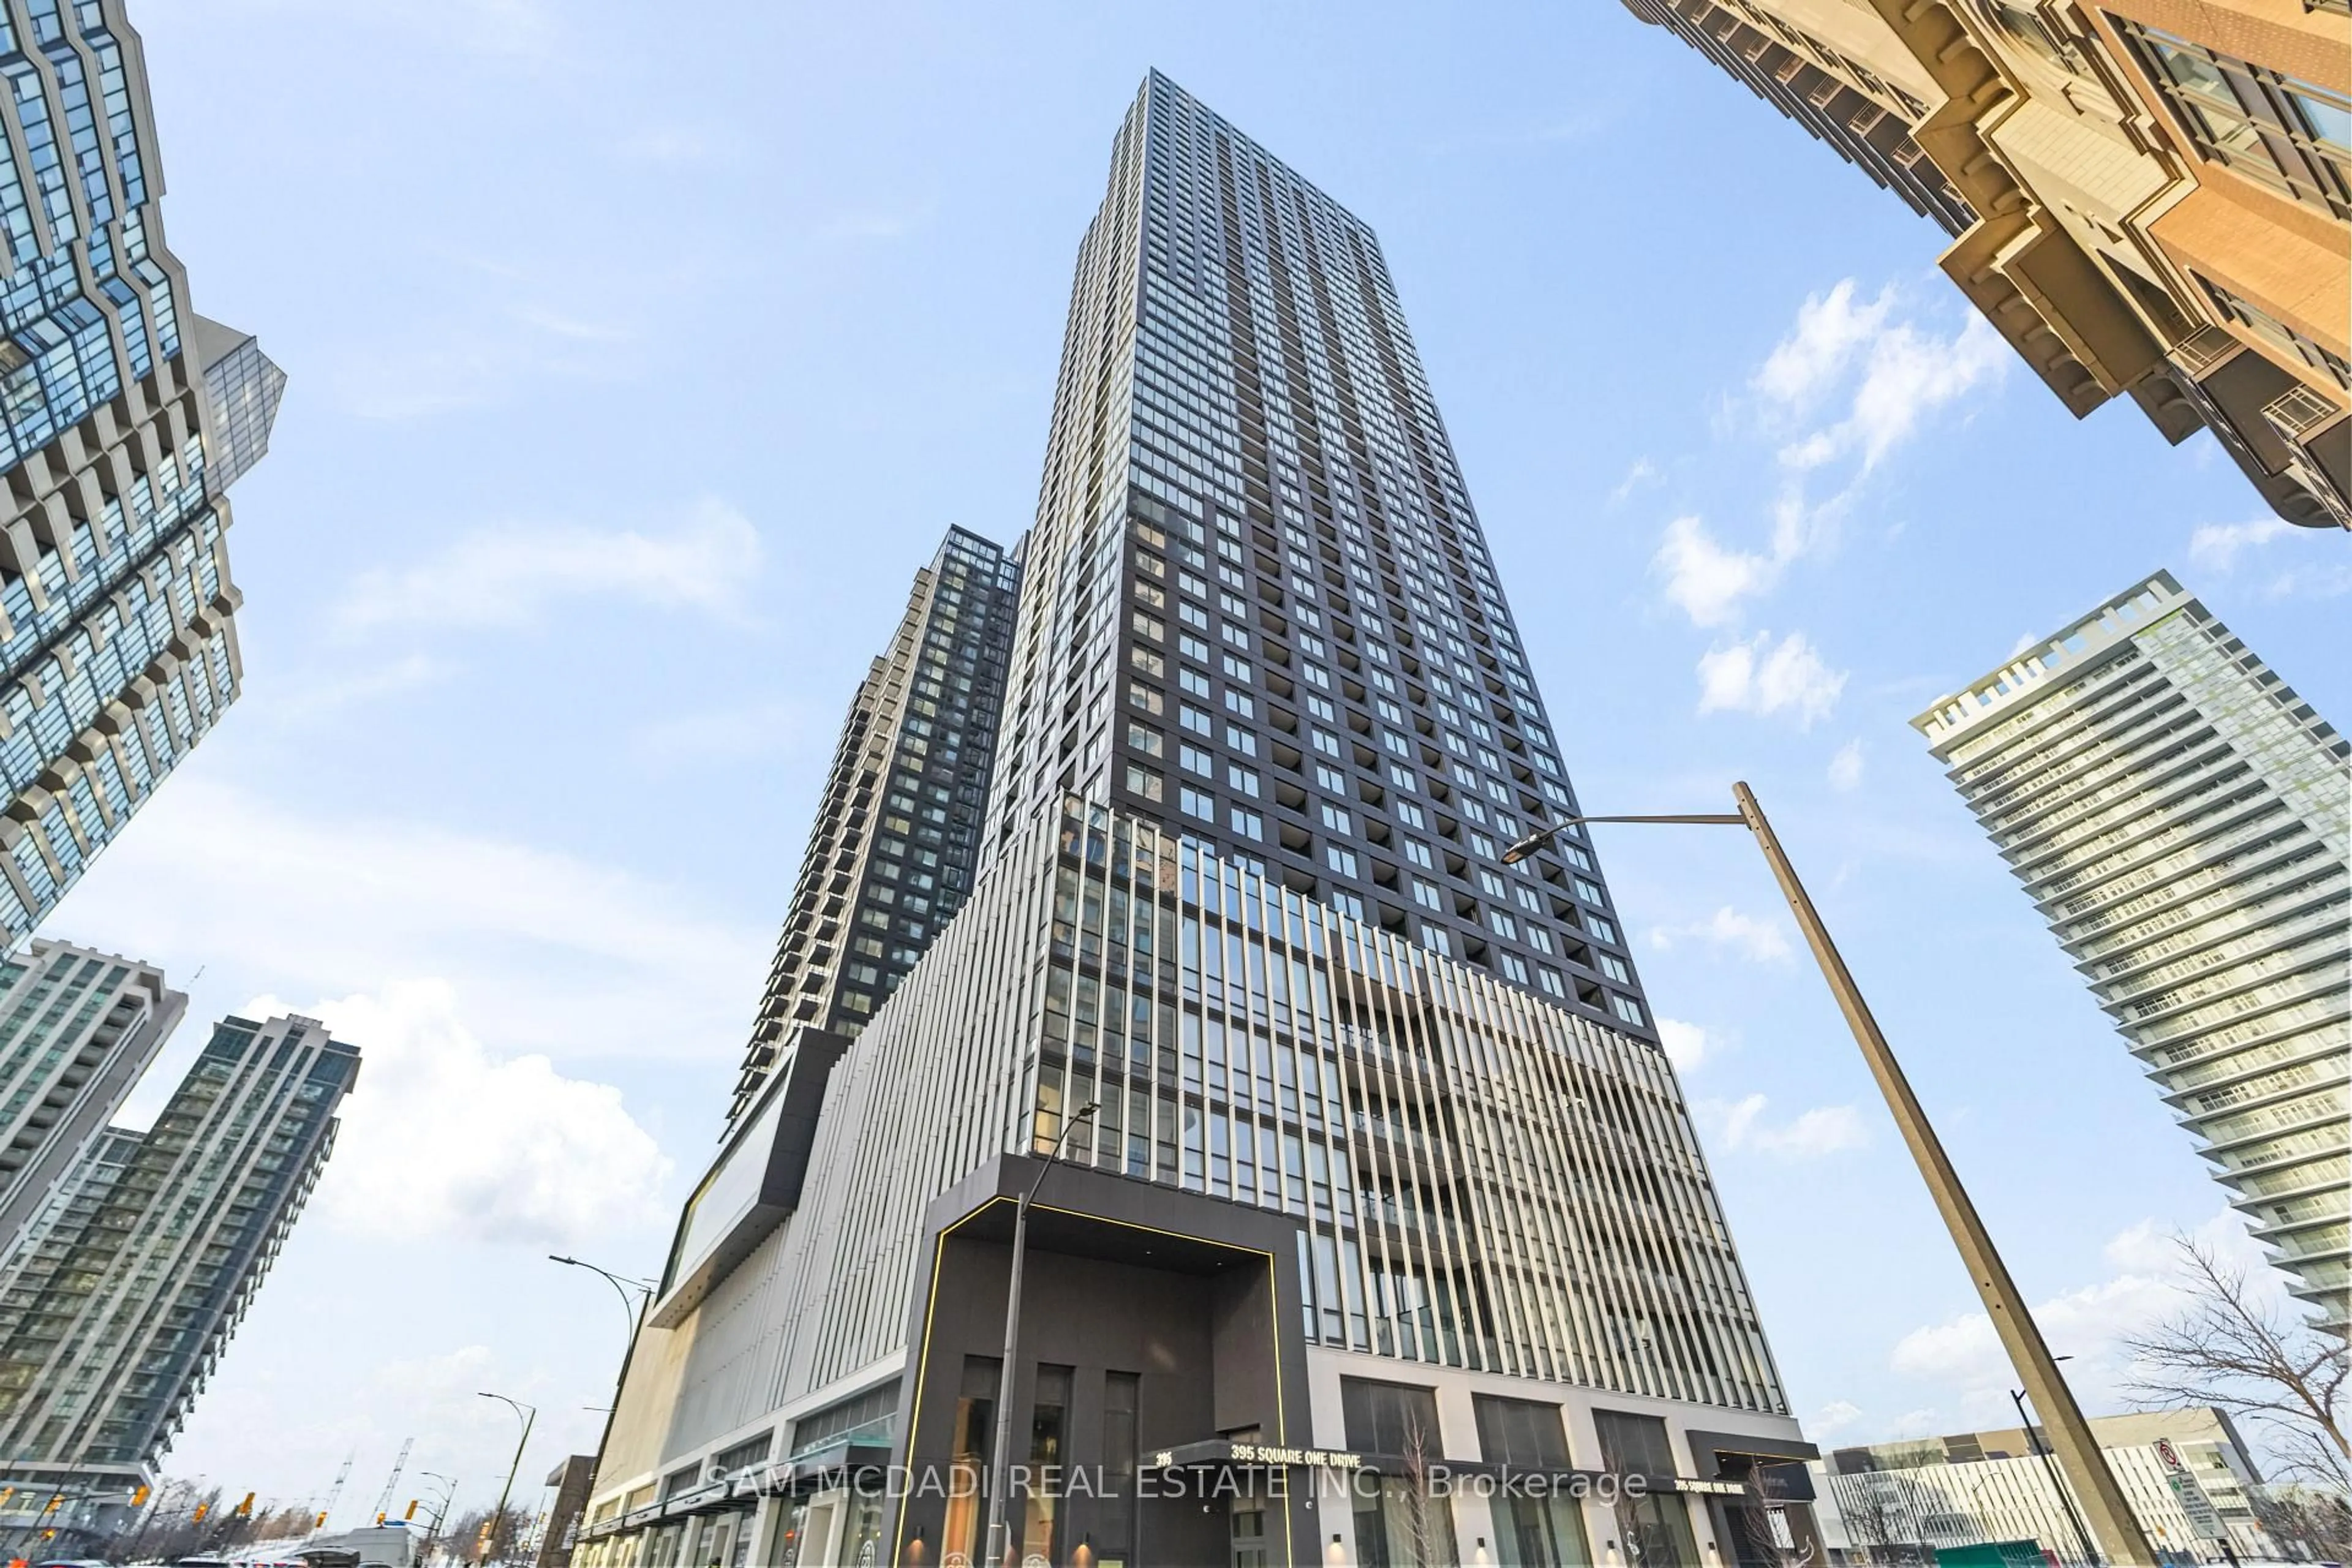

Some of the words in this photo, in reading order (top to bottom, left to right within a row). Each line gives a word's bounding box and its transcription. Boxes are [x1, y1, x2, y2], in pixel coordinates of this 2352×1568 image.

[1156, 1451, 1172, 1467] 395
[1231, 1444, 1254, 1460] 395
[1257, 1447, 1303, 1464] SQUARE
[1305, 1450, 1328, 1466] ONE
[1330, 1452, 1361, 1468] DRIVE
